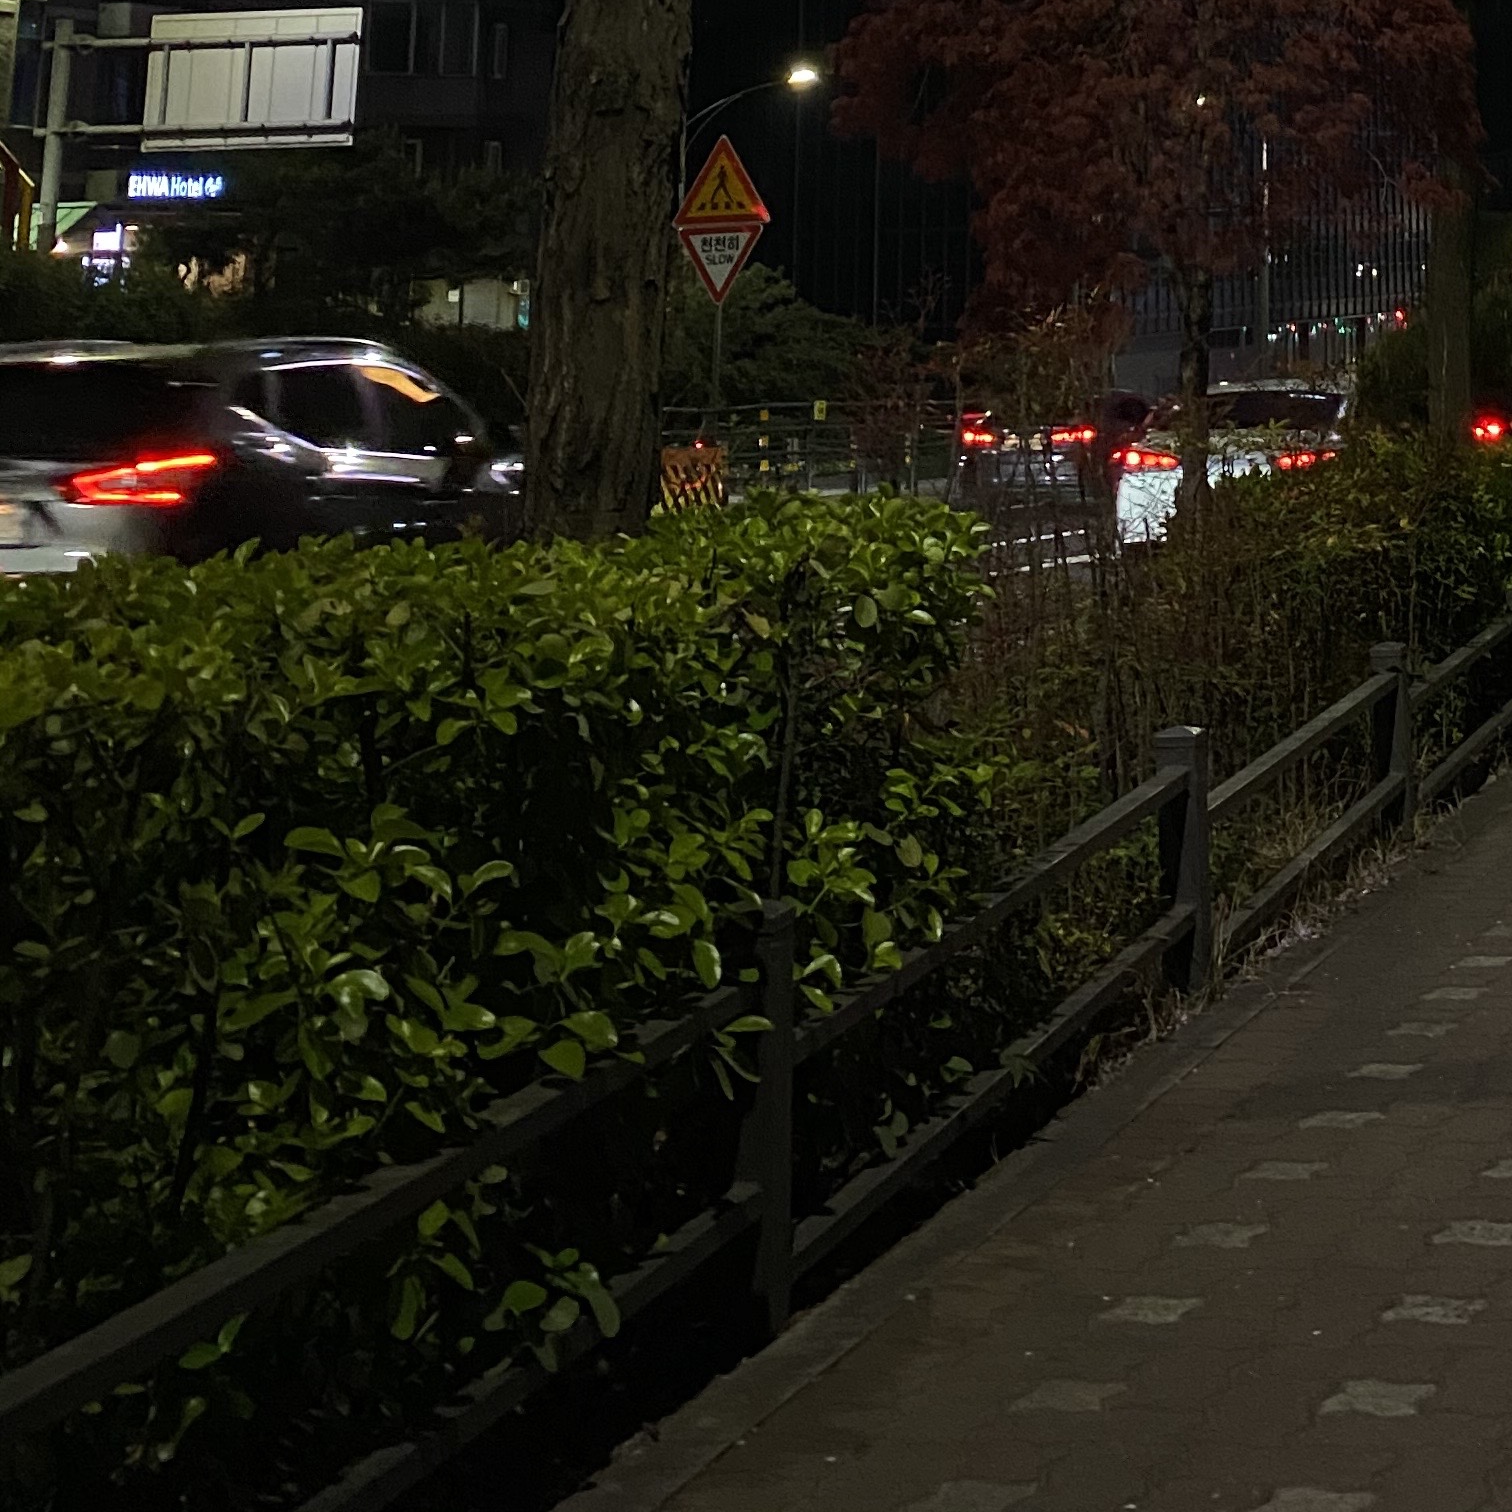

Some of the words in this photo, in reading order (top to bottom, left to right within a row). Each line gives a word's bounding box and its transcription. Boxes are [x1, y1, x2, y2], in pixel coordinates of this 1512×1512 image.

[128, 175, 169, 197] EHWA
[170, 175, 204, 198] Hotel
[700, 234, 740, 253] 천천히
[704, 253, 736, 266] SLOW
